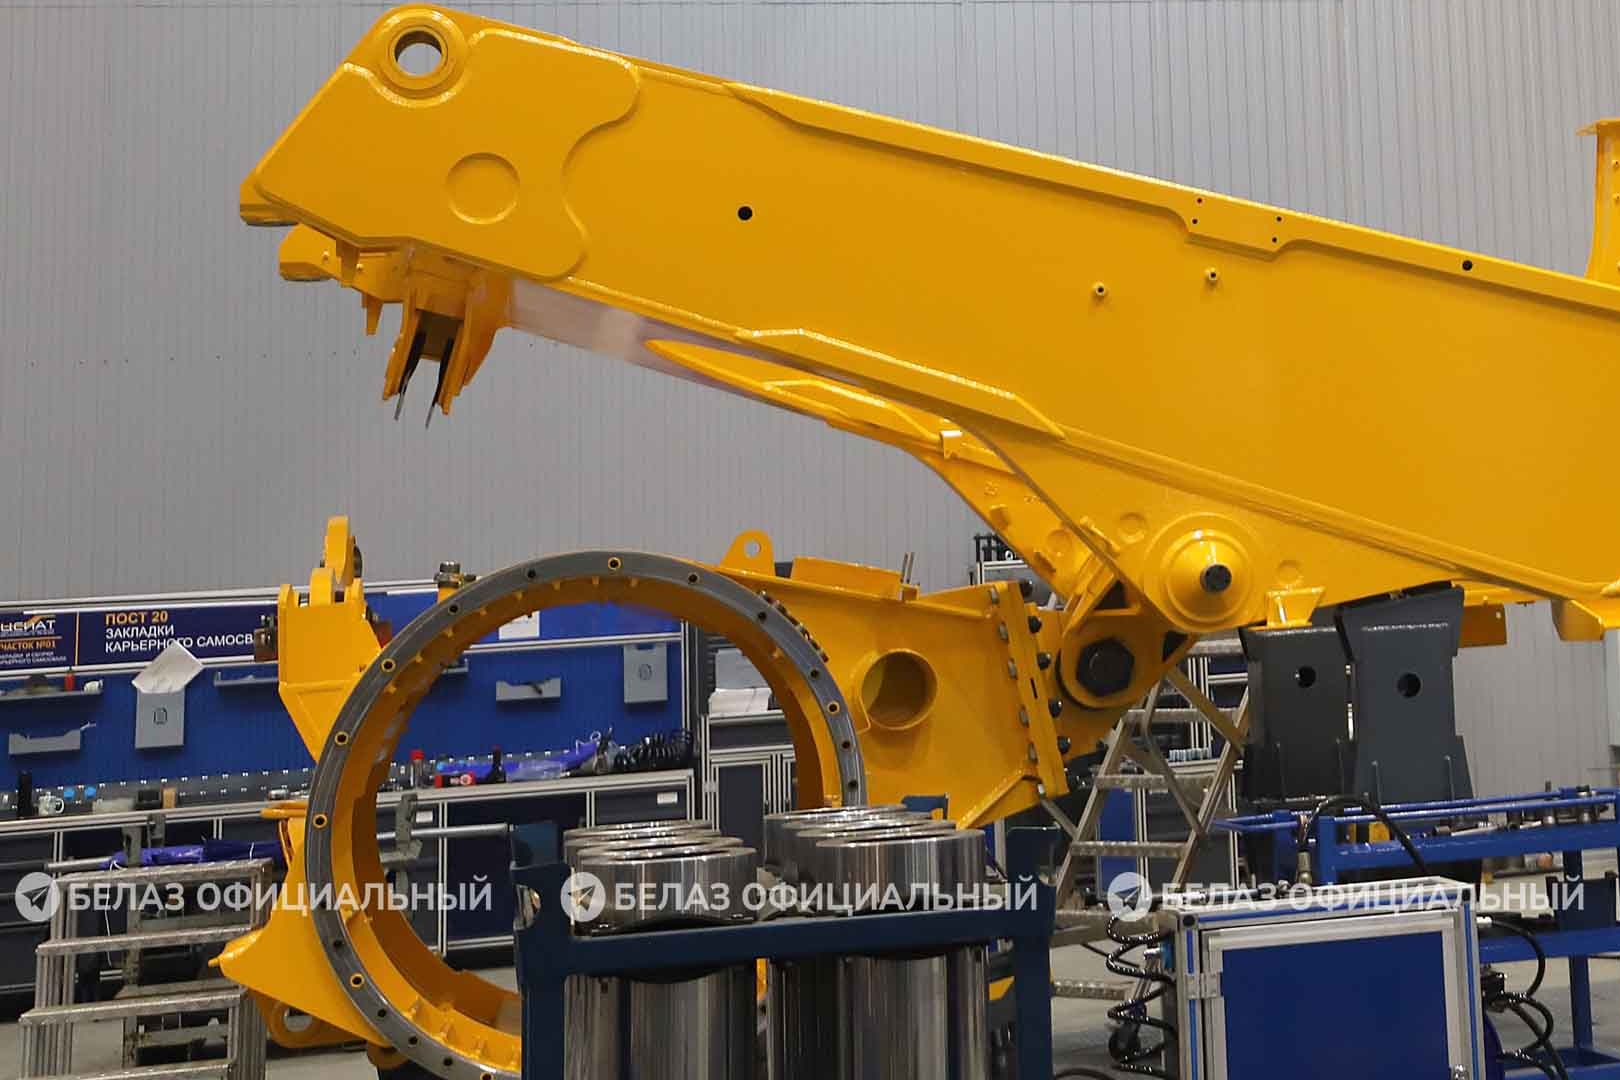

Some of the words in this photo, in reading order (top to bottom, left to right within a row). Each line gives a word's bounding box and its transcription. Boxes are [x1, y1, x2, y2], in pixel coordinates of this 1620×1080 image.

[105, 612, 147, 625] ПОСТ
[152, 611, 168, 623] 20
[105, 624, 174, 639] ЗАКЛАДКИ
[0, 641, 33, 651] ЧАСТОК
[105, 637, 193, 653] КАРЬЕРНОГО
[196, 633, 254, 648] САМОСВ
